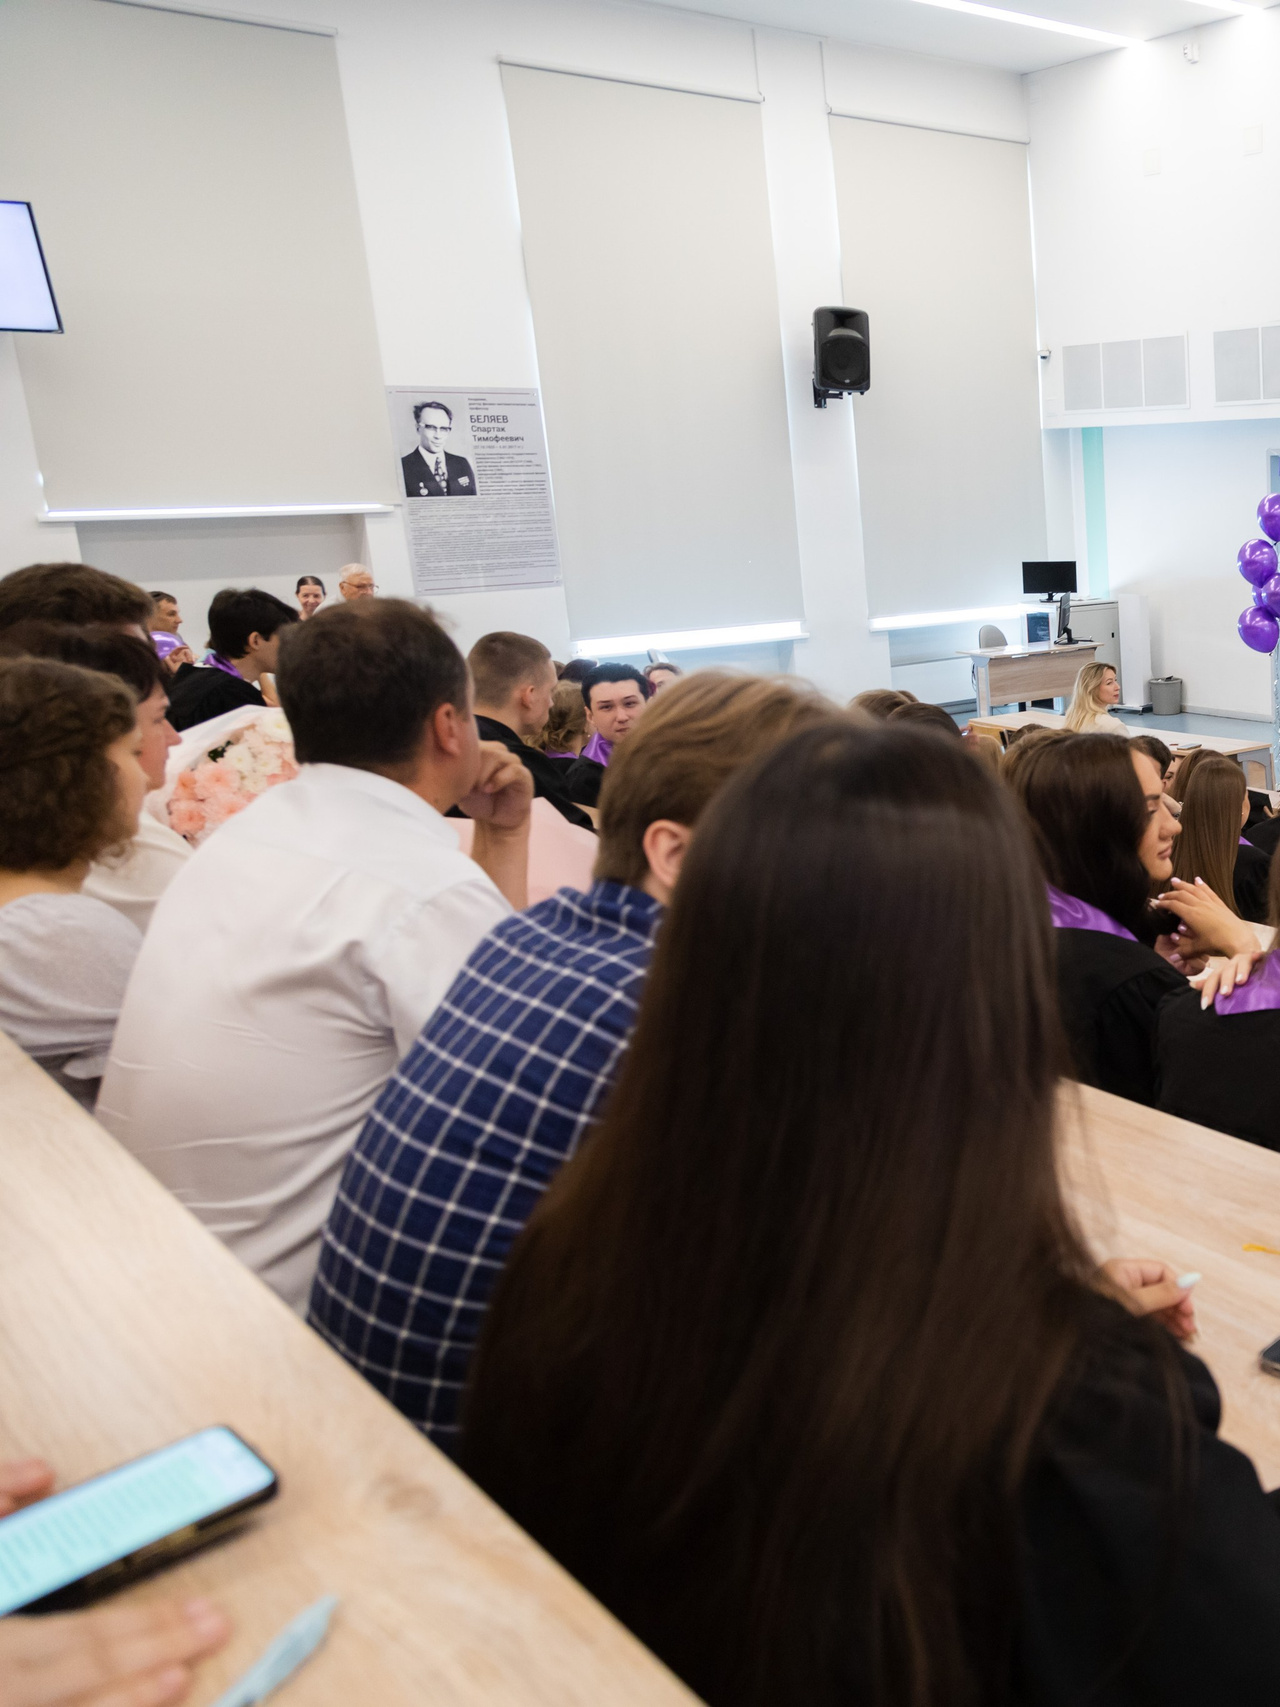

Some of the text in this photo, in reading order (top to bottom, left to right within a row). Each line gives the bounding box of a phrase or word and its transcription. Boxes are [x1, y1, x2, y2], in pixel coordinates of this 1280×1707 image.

[469, 414, 509, 424] БЕЛЯЕВ
[471, 425, 506, 434] Спартак
[472, 434, 525, 443] Тимофеевич
